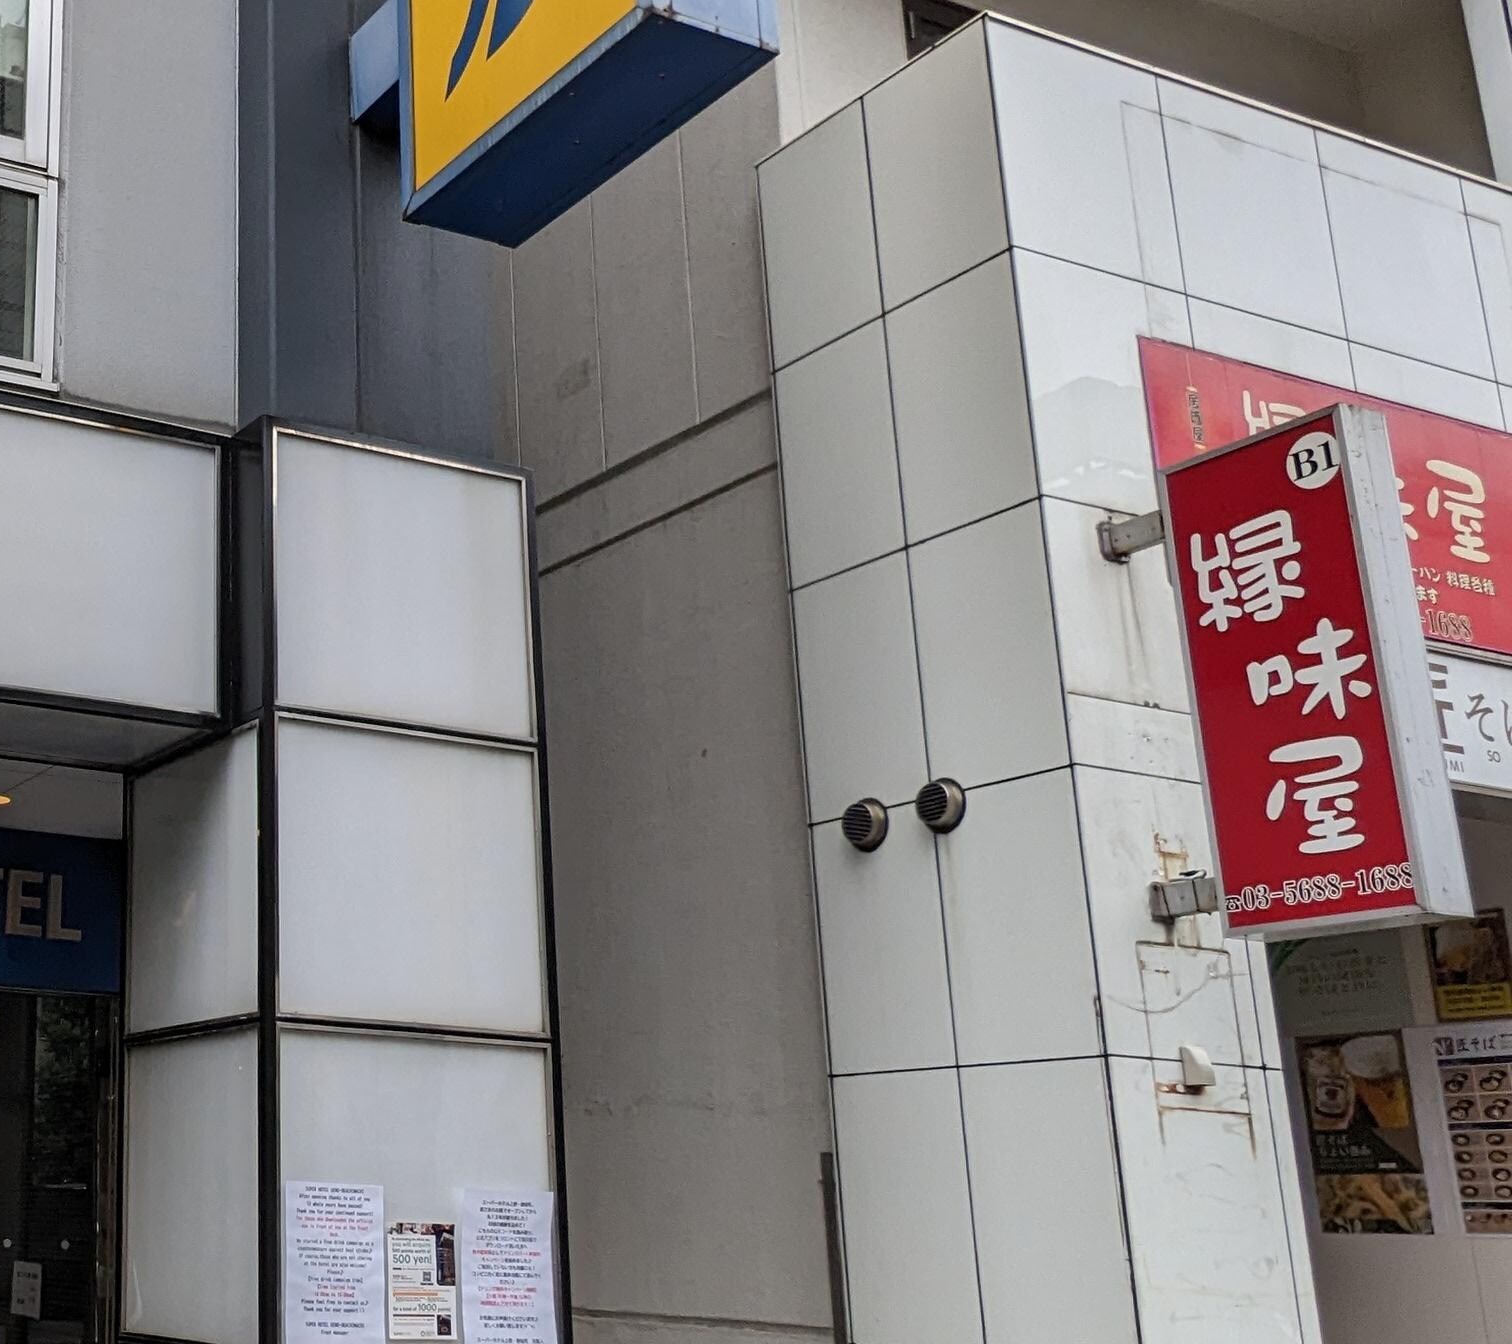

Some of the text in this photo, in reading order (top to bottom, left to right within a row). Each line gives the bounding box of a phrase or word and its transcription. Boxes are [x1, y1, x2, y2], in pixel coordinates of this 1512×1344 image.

[1290, 441, 1339, 482] B1
[1190, 509, 1372, 854] 縁味屋
[392, 1254, 432, 1265] 500 yen!
[418, 1303, 437, 1312] 1000
